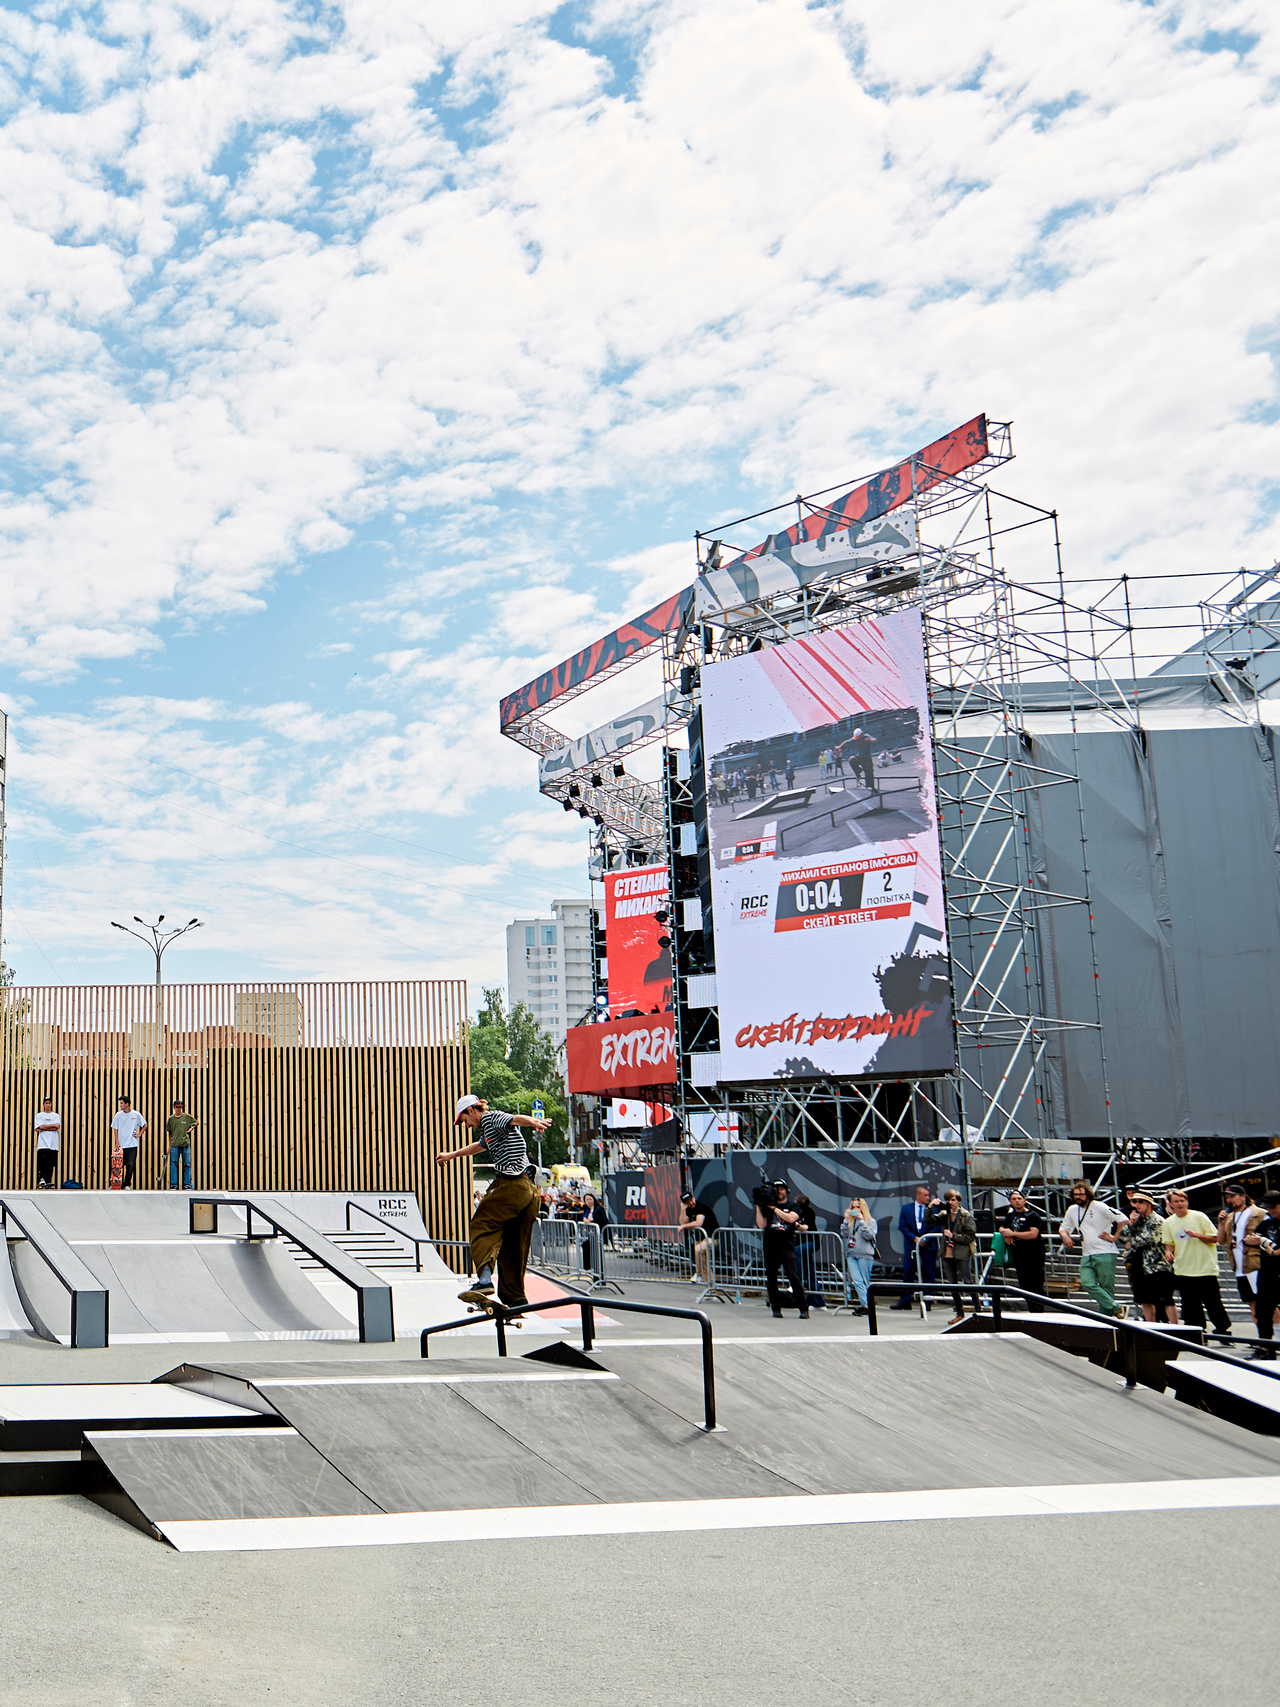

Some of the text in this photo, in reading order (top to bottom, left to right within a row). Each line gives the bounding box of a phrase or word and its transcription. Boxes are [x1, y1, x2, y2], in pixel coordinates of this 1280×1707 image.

[780, 868, 819, 882] МИХАИЛ
[820, 861, 869, 876] СТЕПАНОВ
[883, 871, 892, 892] 2
[741, 894, 769, 910] RCC
[795, 878, 842, 912] 0:04
[867, 893, 911, 906] ПОПЫТКА
[740, 909, 768, 919] EXTREME
[803, 910, 877, 930] СКЕЙТ STREET
[378, 1199, 407, 1210] RCC
[379, 1210, 408, 1218] EXTREME
